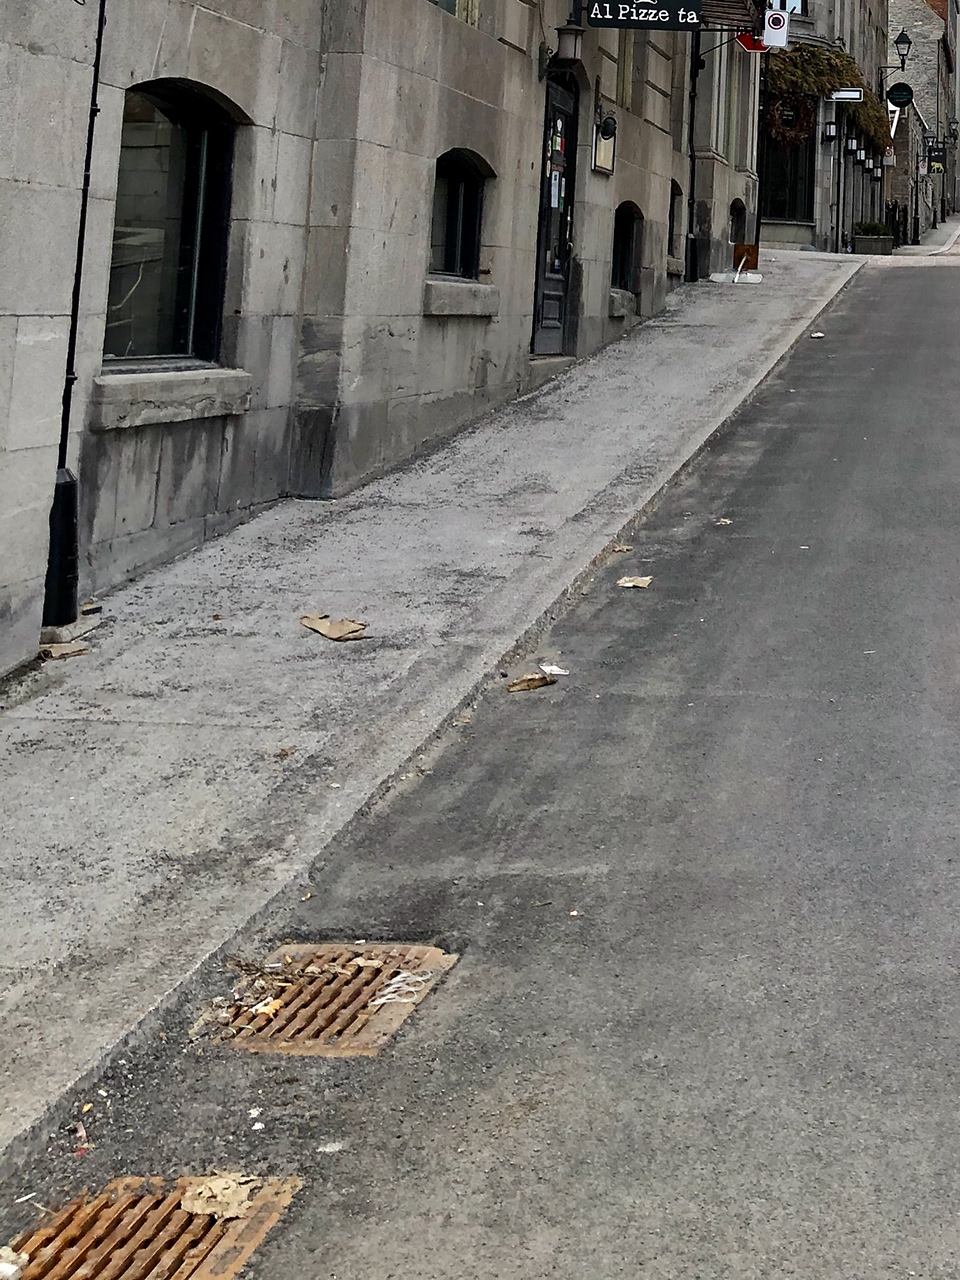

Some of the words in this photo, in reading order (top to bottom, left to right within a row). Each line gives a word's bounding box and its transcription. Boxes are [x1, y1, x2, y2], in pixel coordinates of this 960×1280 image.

[590, 3, 613, 19] Al
[617, 3, 670, 21] Pizze
[677, 7, 699, 24] ta
